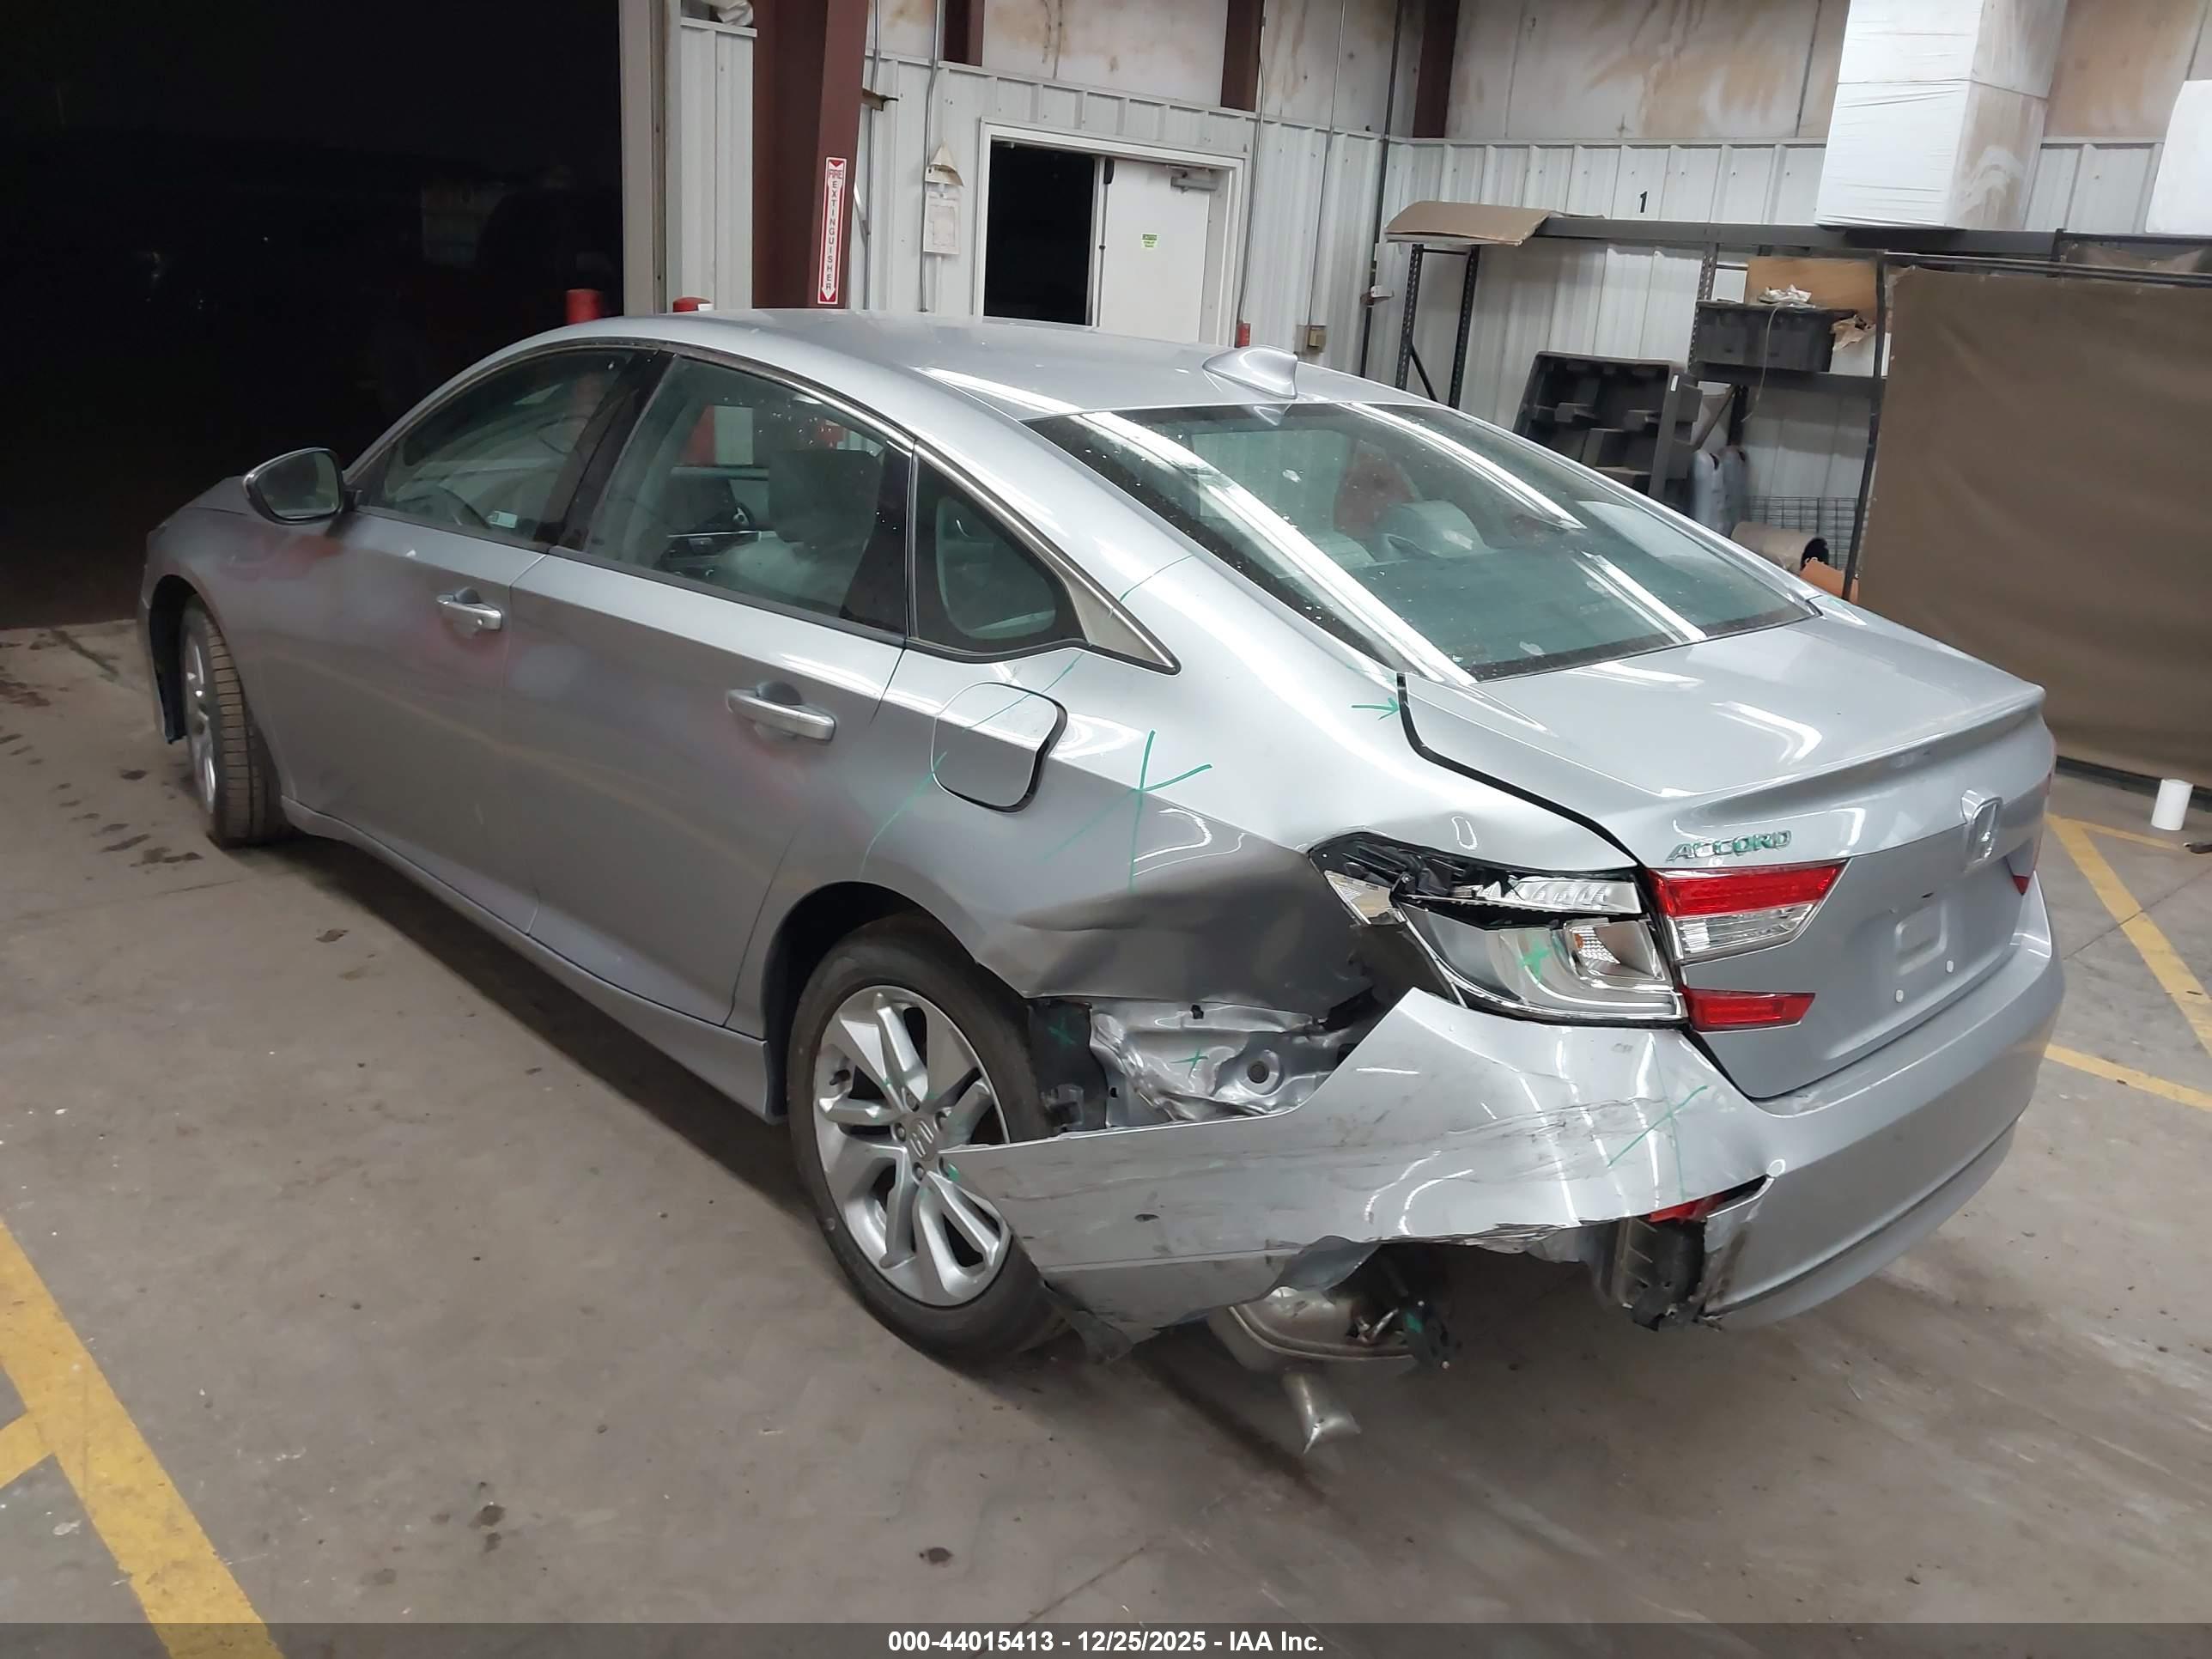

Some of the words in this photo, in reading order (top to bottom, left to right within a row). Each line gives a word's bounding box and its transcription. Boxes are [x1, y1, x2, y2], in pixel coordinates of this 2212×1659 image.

[828, 168, 843, 179] FIRE
[1639, 191, 1648, 214] 1
[825, 180, 839, 290] EXTINGUISHER
[1666, 830, 1792, 861] ACCORD
